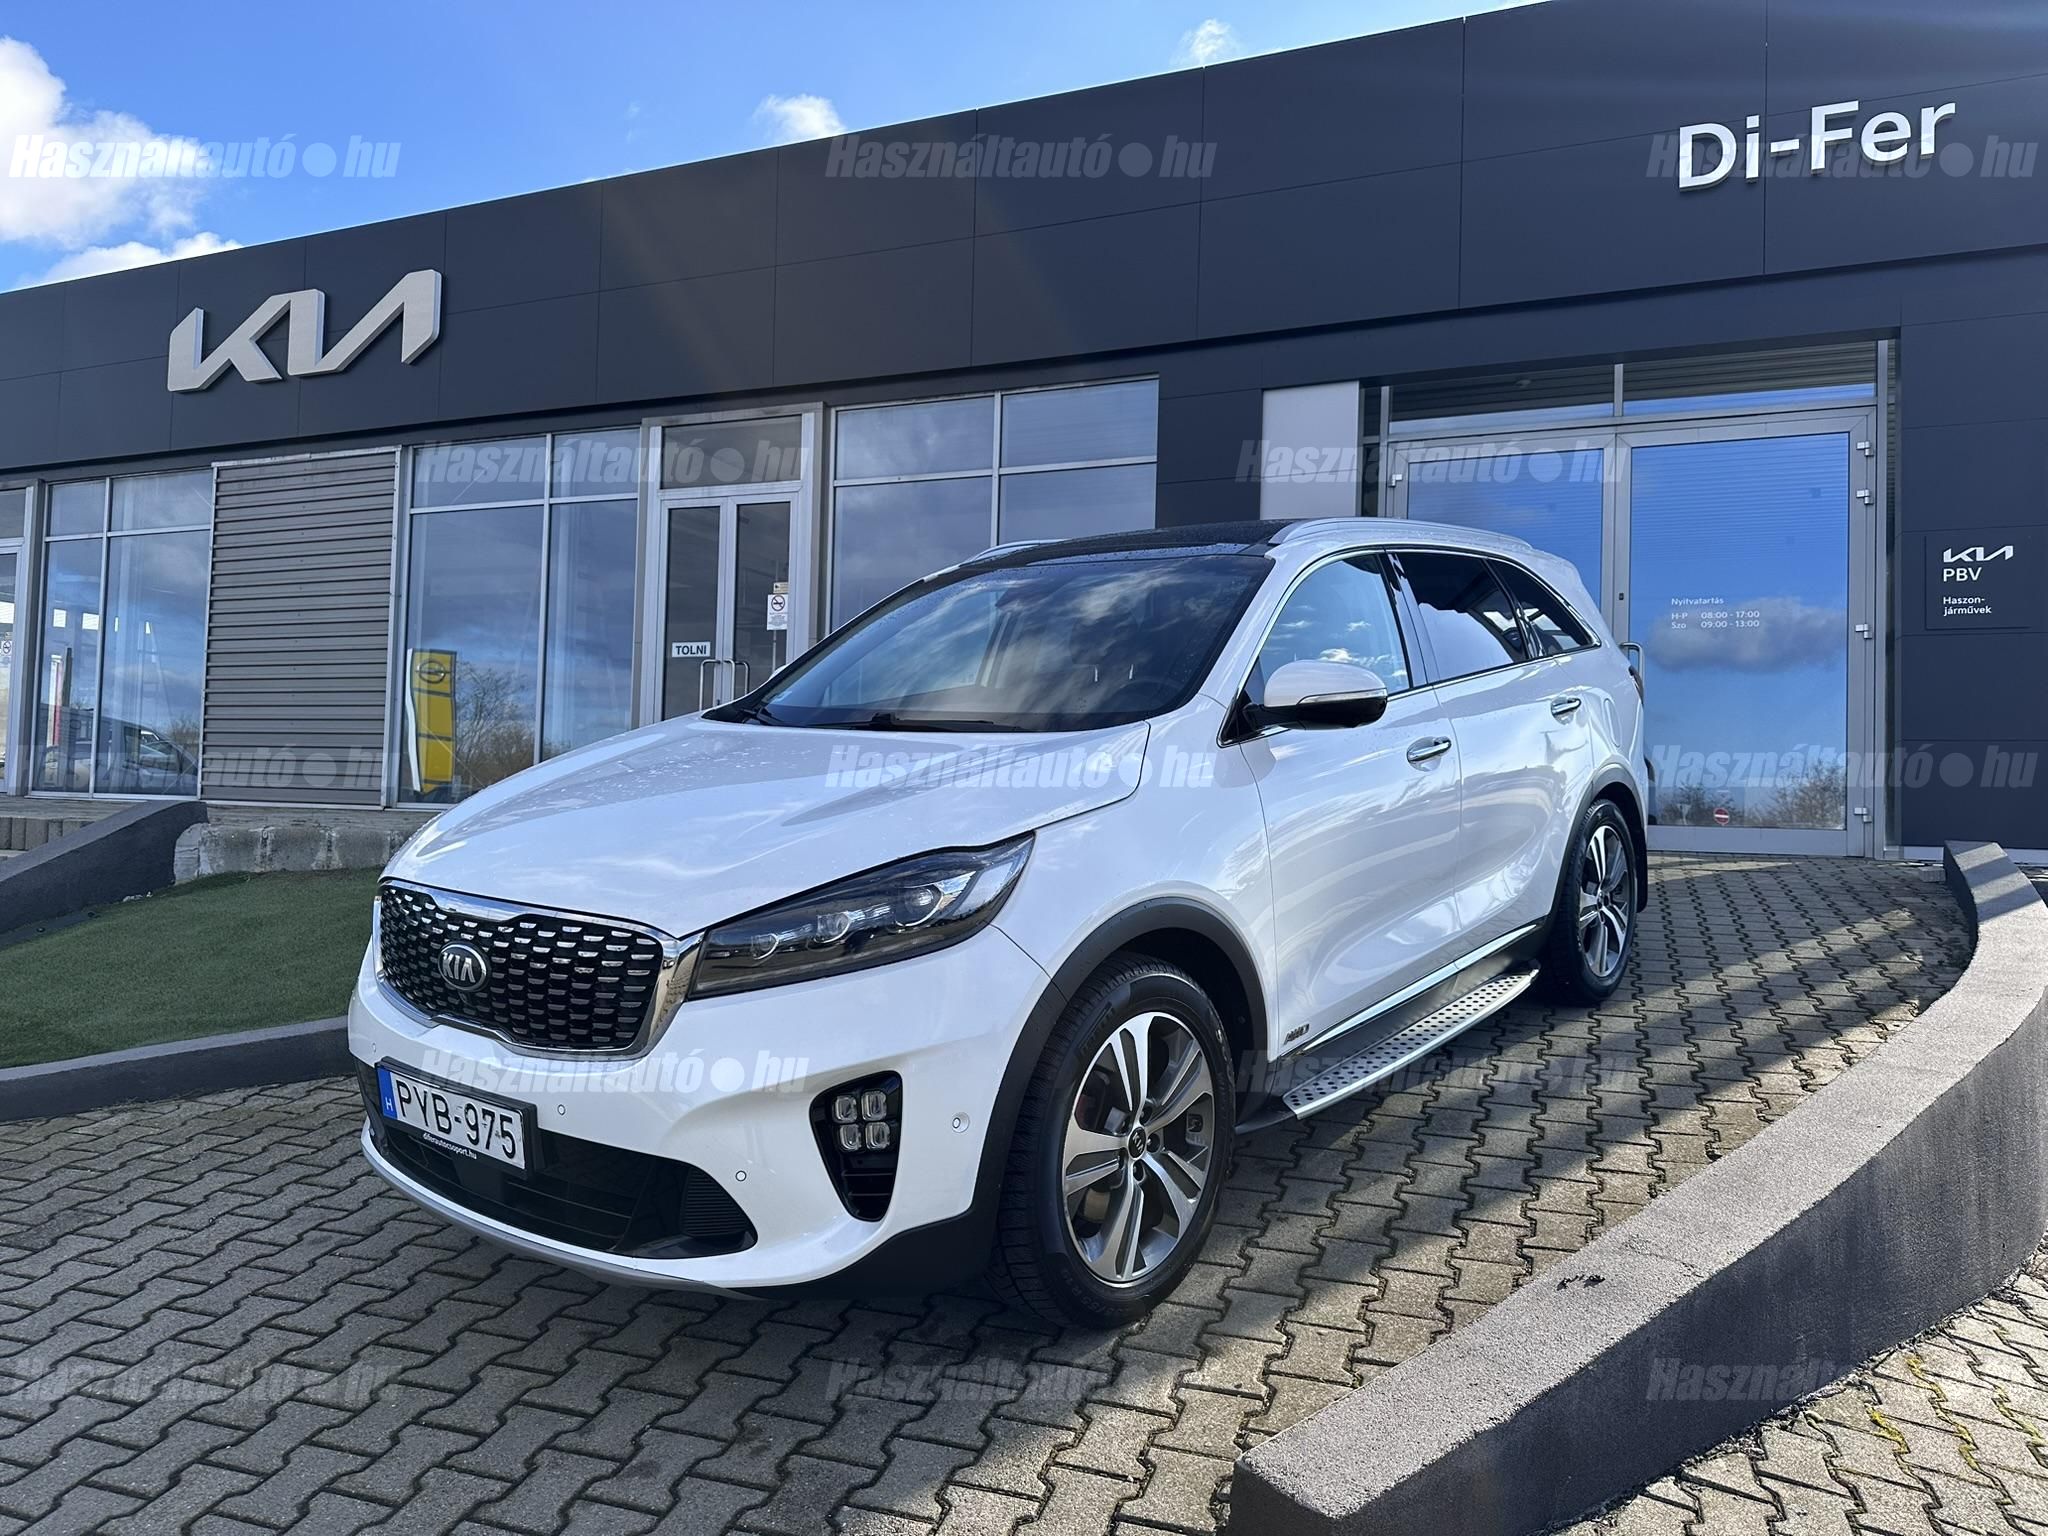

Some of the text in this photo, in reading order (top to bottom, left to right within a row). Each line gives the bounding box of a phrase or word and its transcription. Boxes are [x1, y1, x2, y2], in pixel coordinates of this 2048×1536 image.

[1679, 100, 1956, 192] Di-Fer
[168, 269, 441, 392] KIA
[1943, 567, 1982, 582] PBV
[1671, 597, 1725, 606] Nyitvatartás
[1943, 596, 1986, 605] Haszon-
[1671, 612, 1688, 620] H-P
[1701, 610, 1728, 619] 08:00
[1735, 610, 1760, 618] 17:00
[1943, 605, 1992, 616] járművek
[1671, 621, 1687, 629] Szo
[1735, 619, 1760, 628] 13:00
[675, 645, 707, 656] TOLNI
[442, 952, 477, 984] KIA
[384, 1097, 394, 1112] H
[395, 1079, 517, 1160] PYB-975
